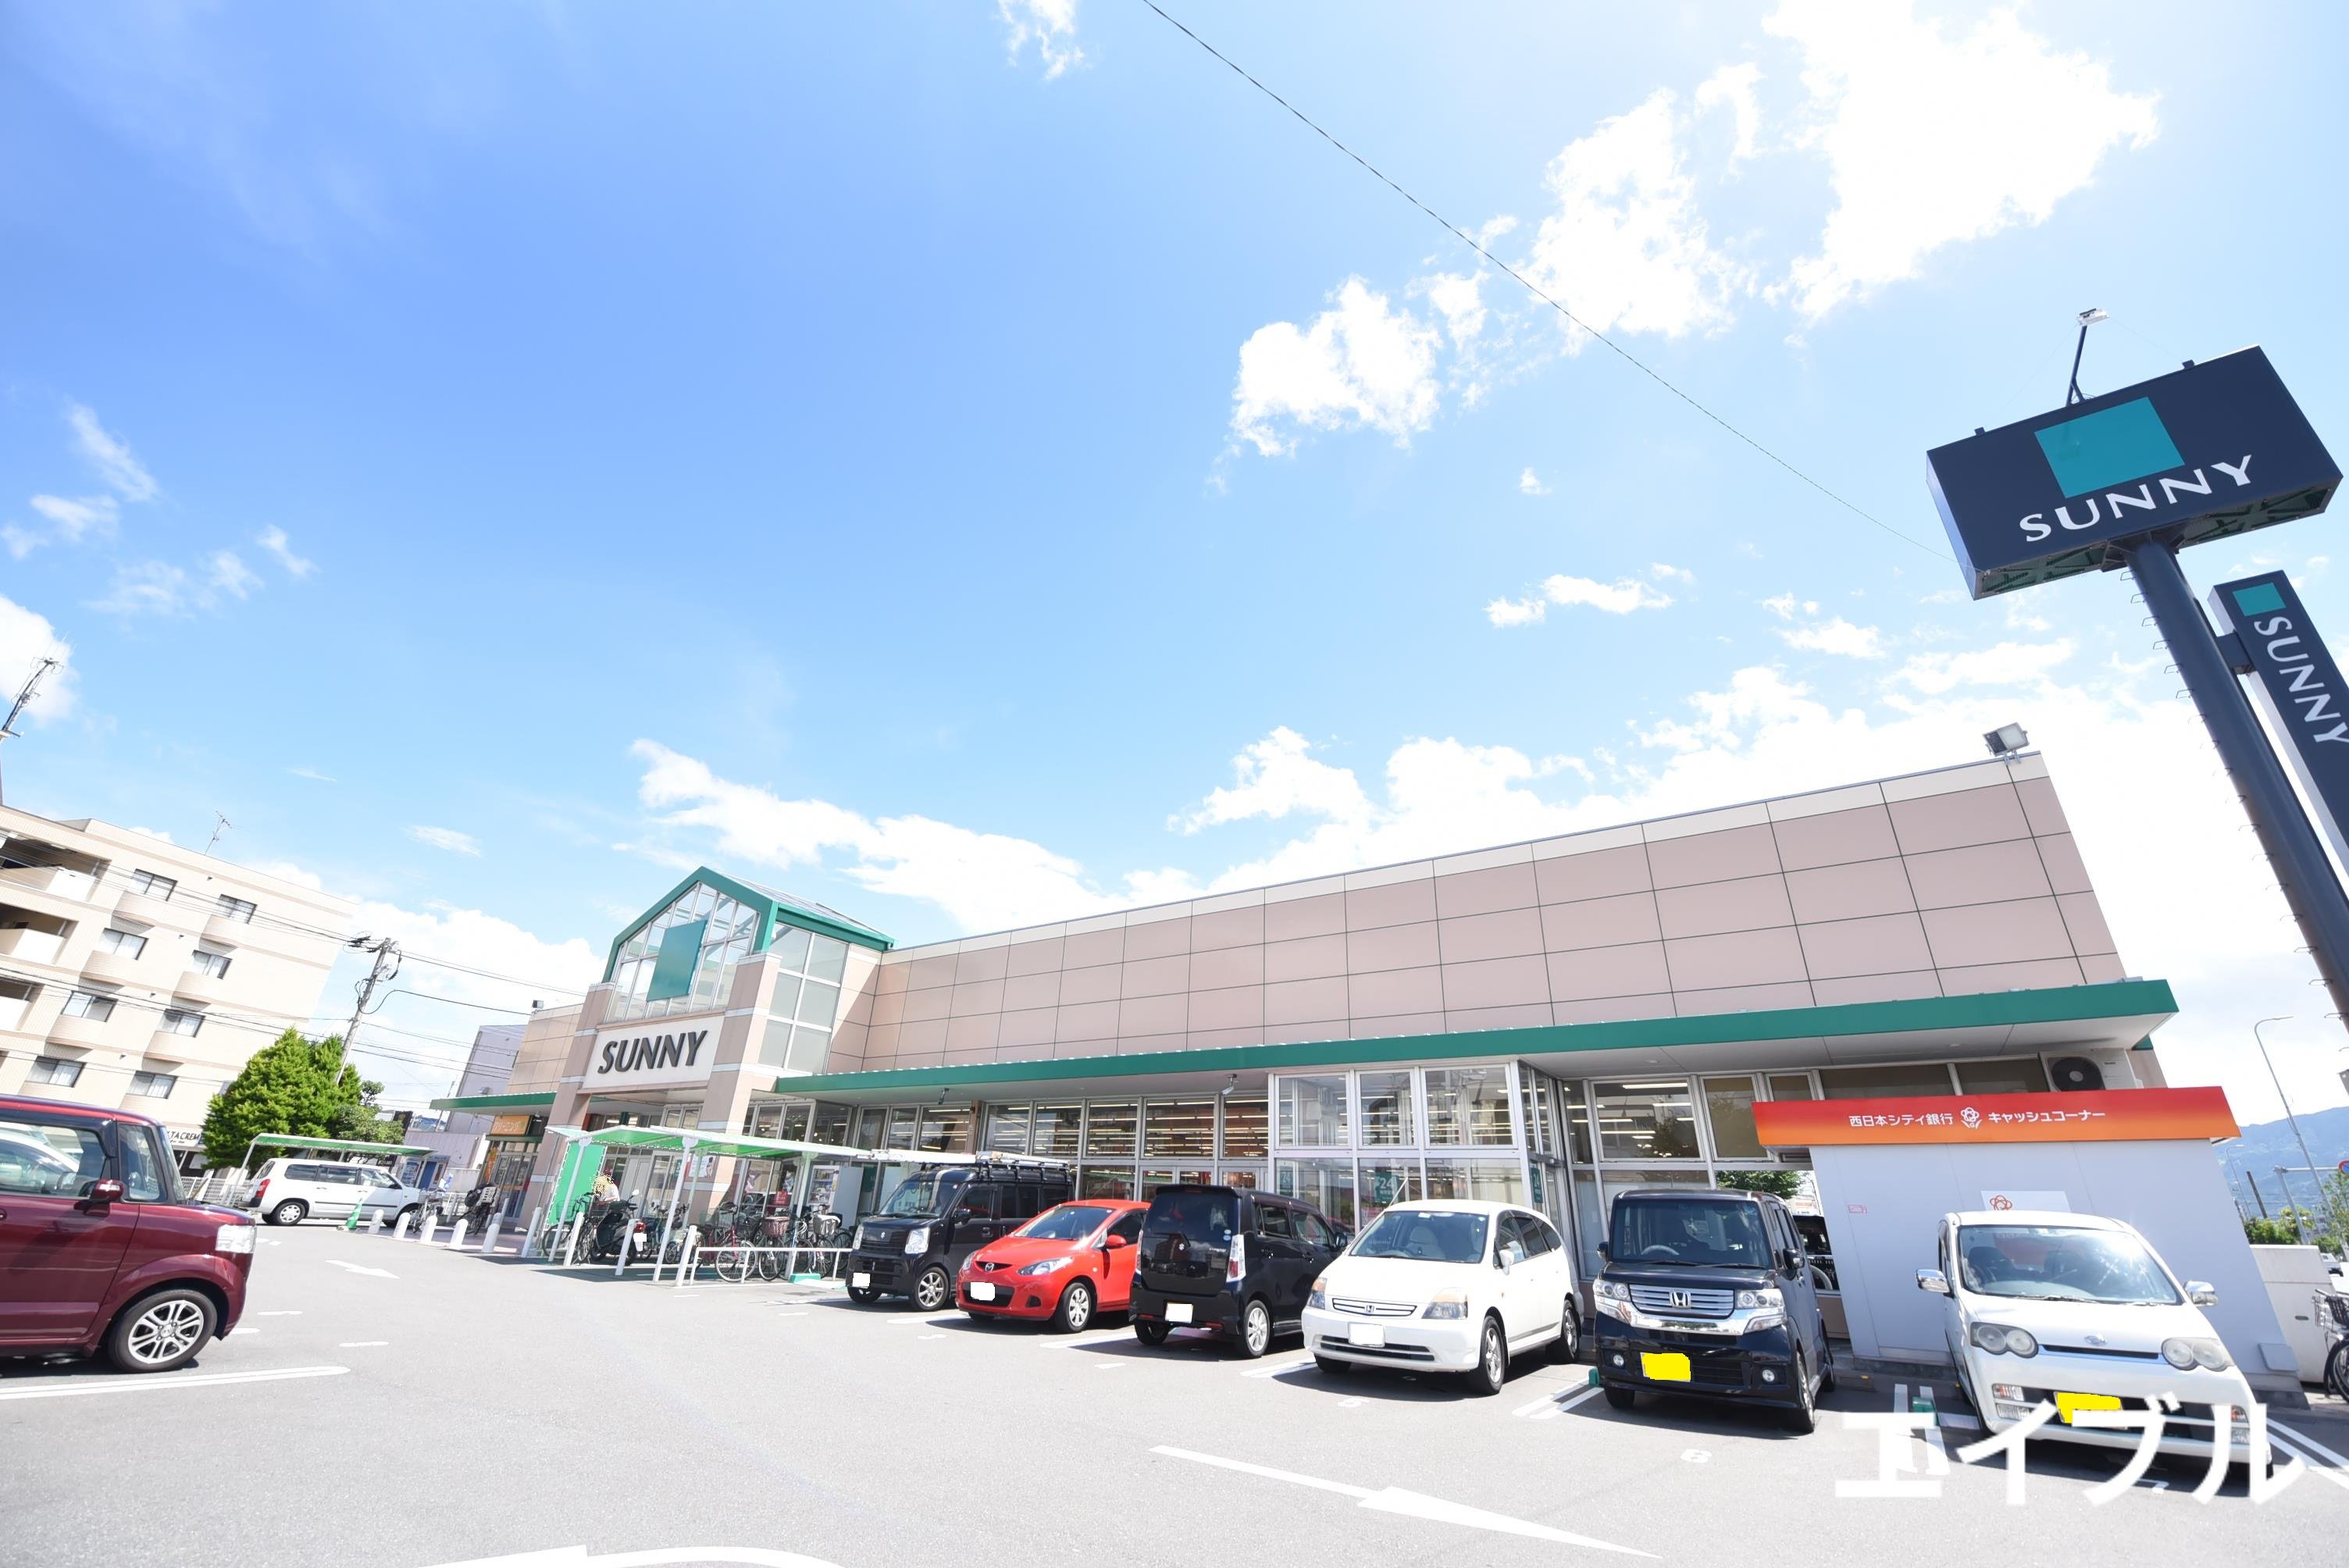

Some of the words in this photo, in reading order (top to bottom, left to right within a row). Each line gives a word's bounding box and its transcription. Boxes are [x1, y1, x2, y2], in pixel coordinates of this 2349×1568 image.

[2019, 454, 2251, 542] SUNNY
[2253, 616, 2349, 743] SUNNY
[597, 1030, 708, 1074] SUNNY
[1848, 1112, 1953, 1128] 西日本シティ銀行
[1987, 1109, 2106, 1124] キャッシュコーナー
